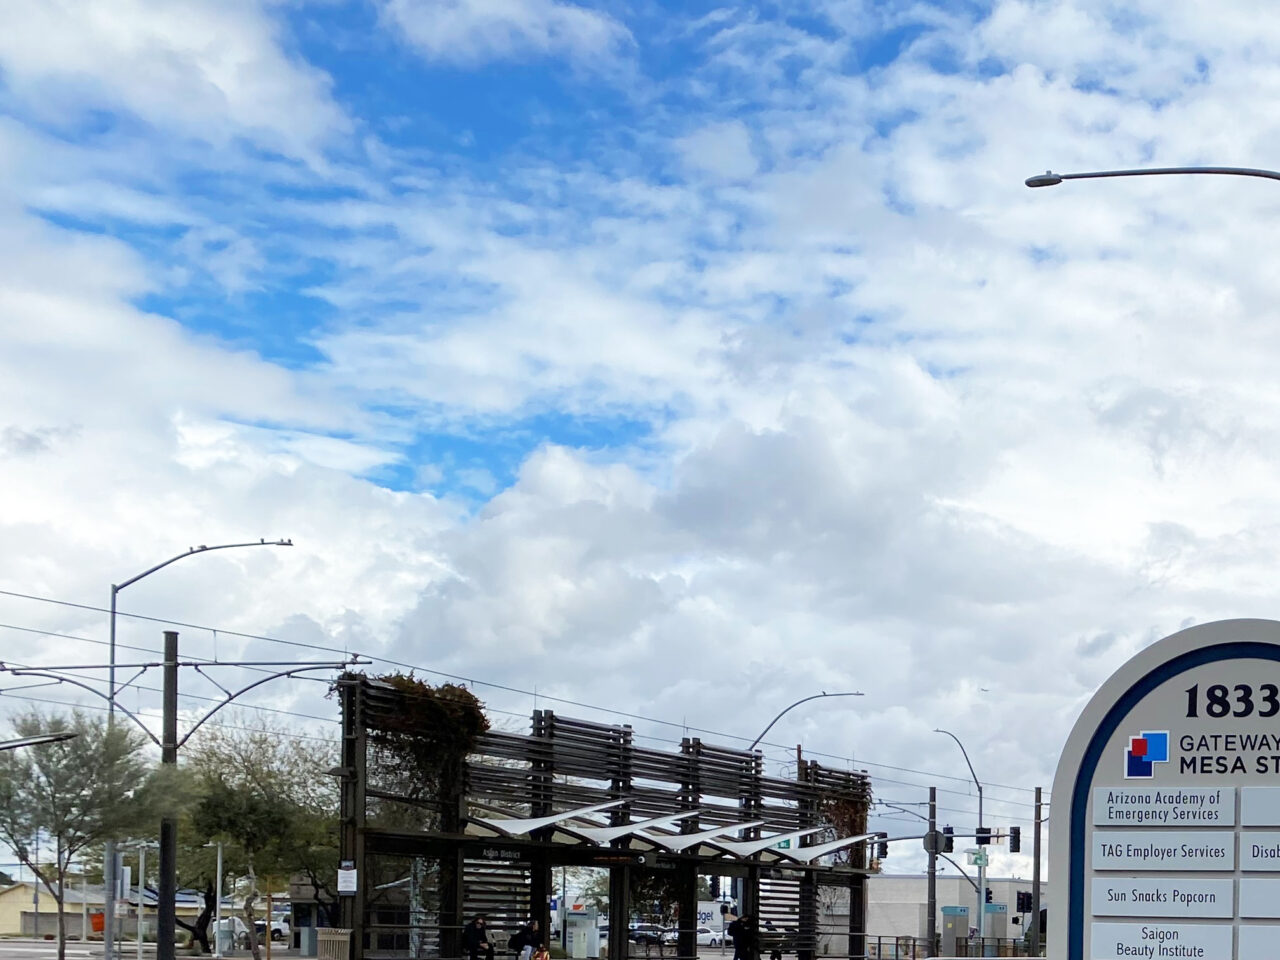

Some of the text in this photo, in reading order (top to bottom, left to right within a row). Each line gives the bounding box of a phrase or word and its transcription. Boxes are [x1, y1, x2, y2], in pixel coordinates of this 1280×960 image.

[1185, 683, 1280, 718] 1833
[1180, 756, 1247, 774] MESA
[1107, 790, 1221, 807] Arizona Academy of
[1108, 806, 1219, 823] Emergency Services
[1101, 843, 1226, 860] TAG Employer Services
[1107, 888, 1216, 907] Sun Snacks Popcorn
[1141, 926, 1179, 943] Saigon
[1116, 942, 1204, 960] Beauty Institute
